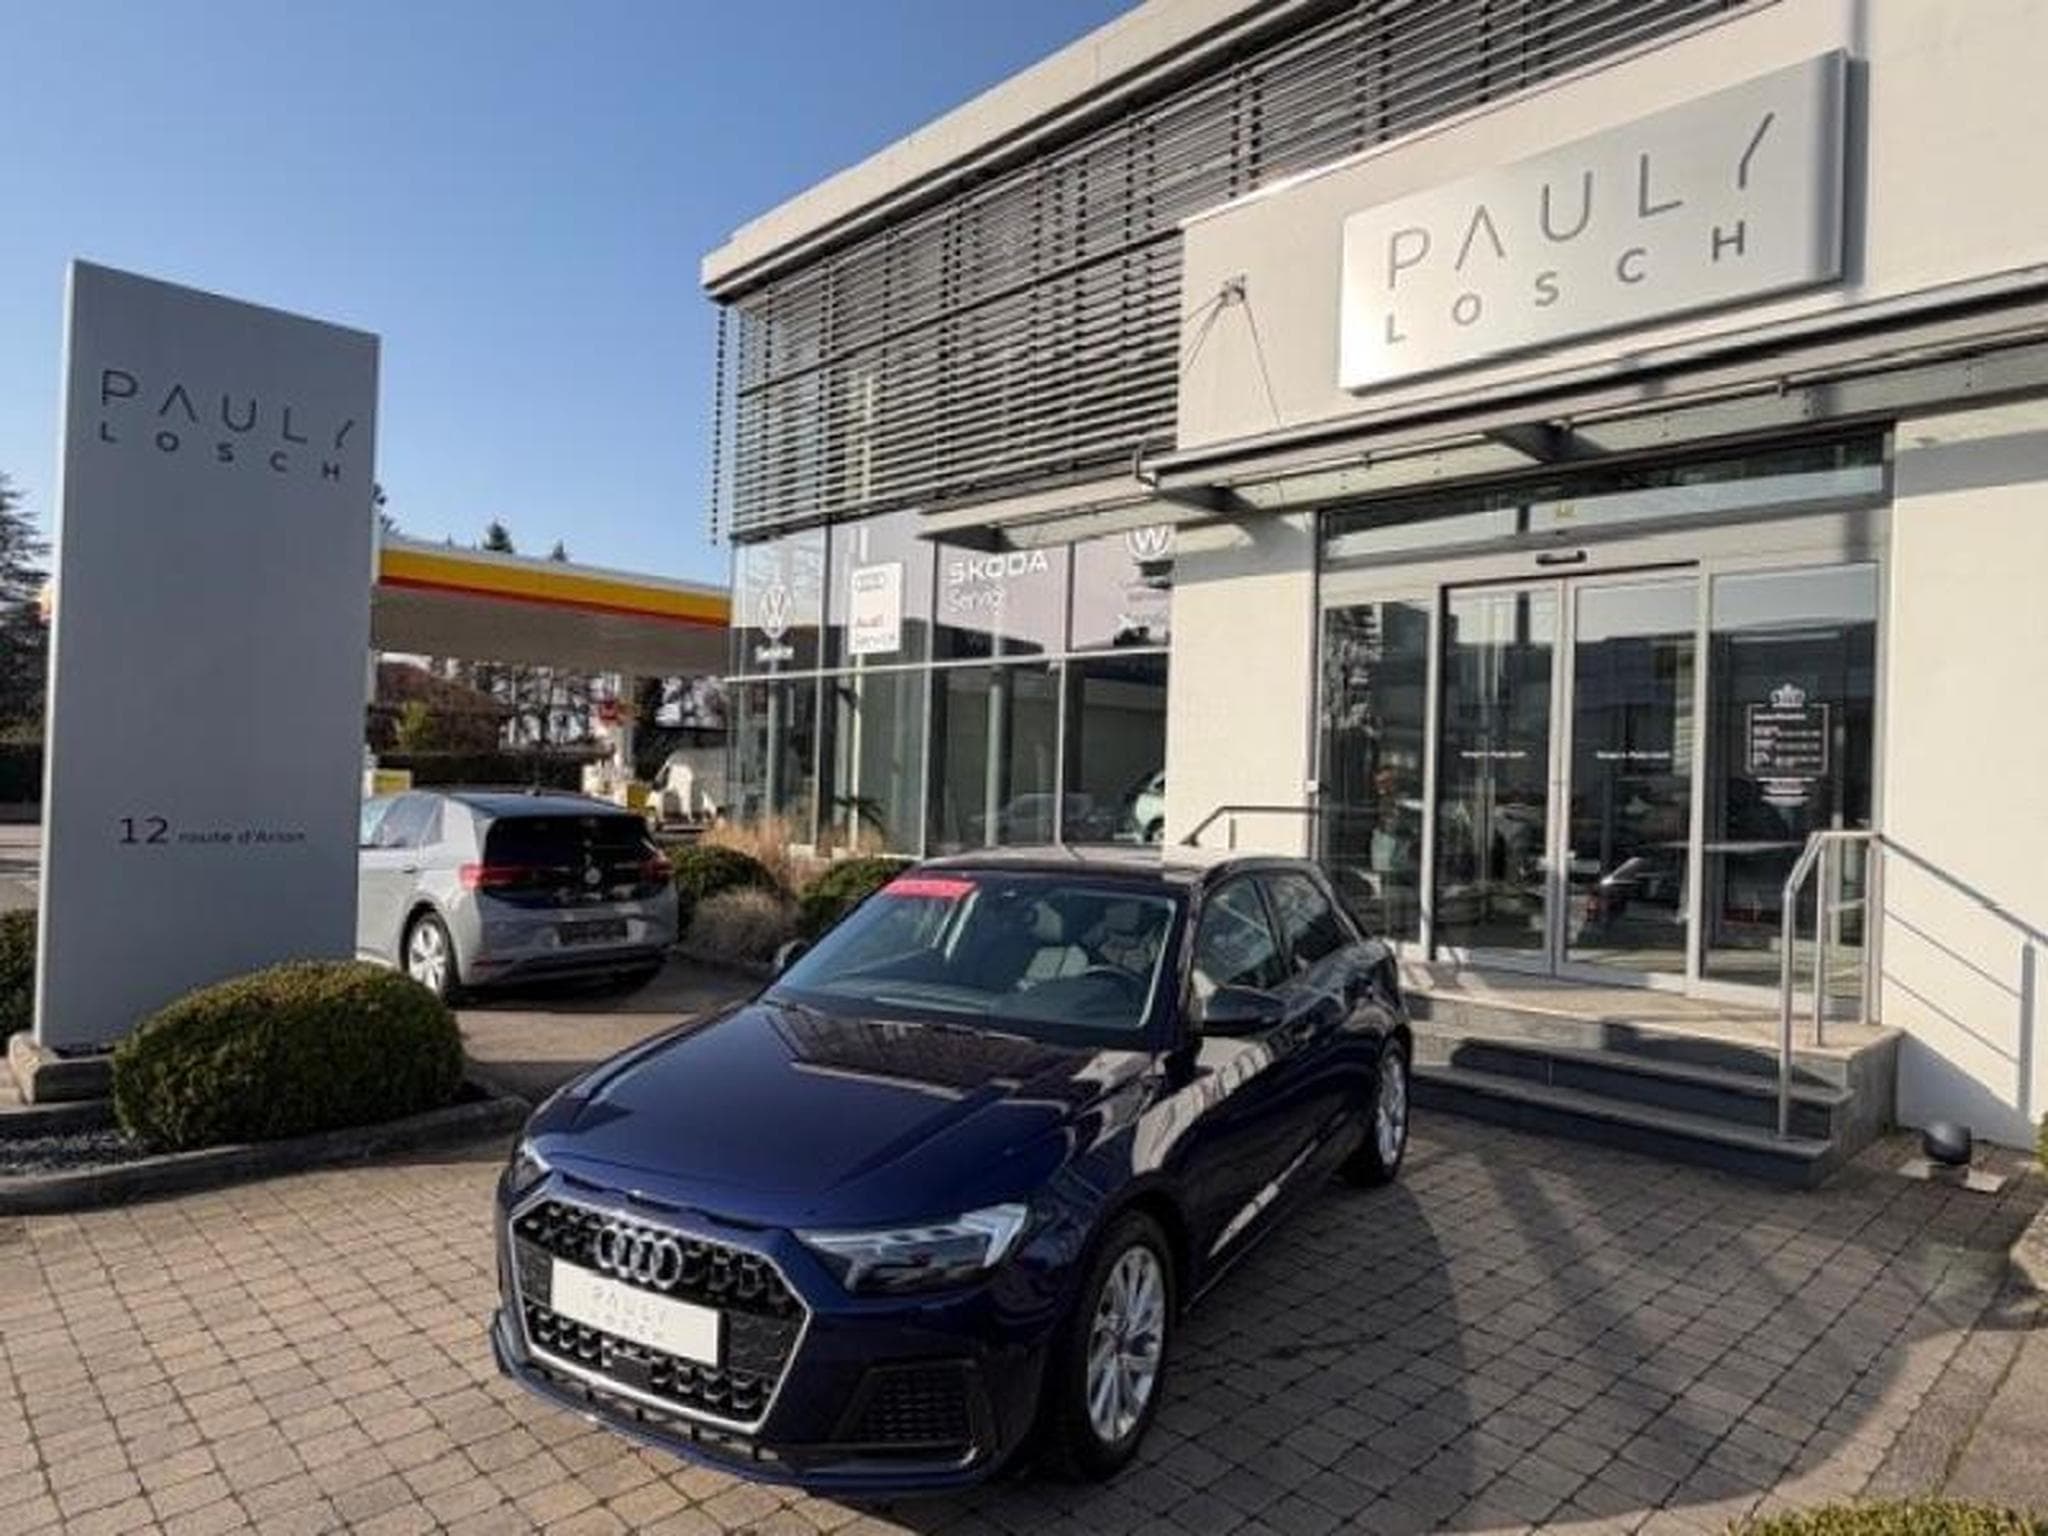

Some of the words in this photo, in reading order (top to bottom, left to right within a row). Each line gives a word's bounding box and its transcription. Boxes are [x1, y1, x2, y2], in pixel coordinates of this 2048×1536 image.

[1389, 112, 1775, 288] PAULY
[1384, 220, 1747, 344] LOSCH
[102, 369, 355, 449] PAULY
[101, 421, 340, 482] LOSCH
[119, 815, 170, 845] 12
